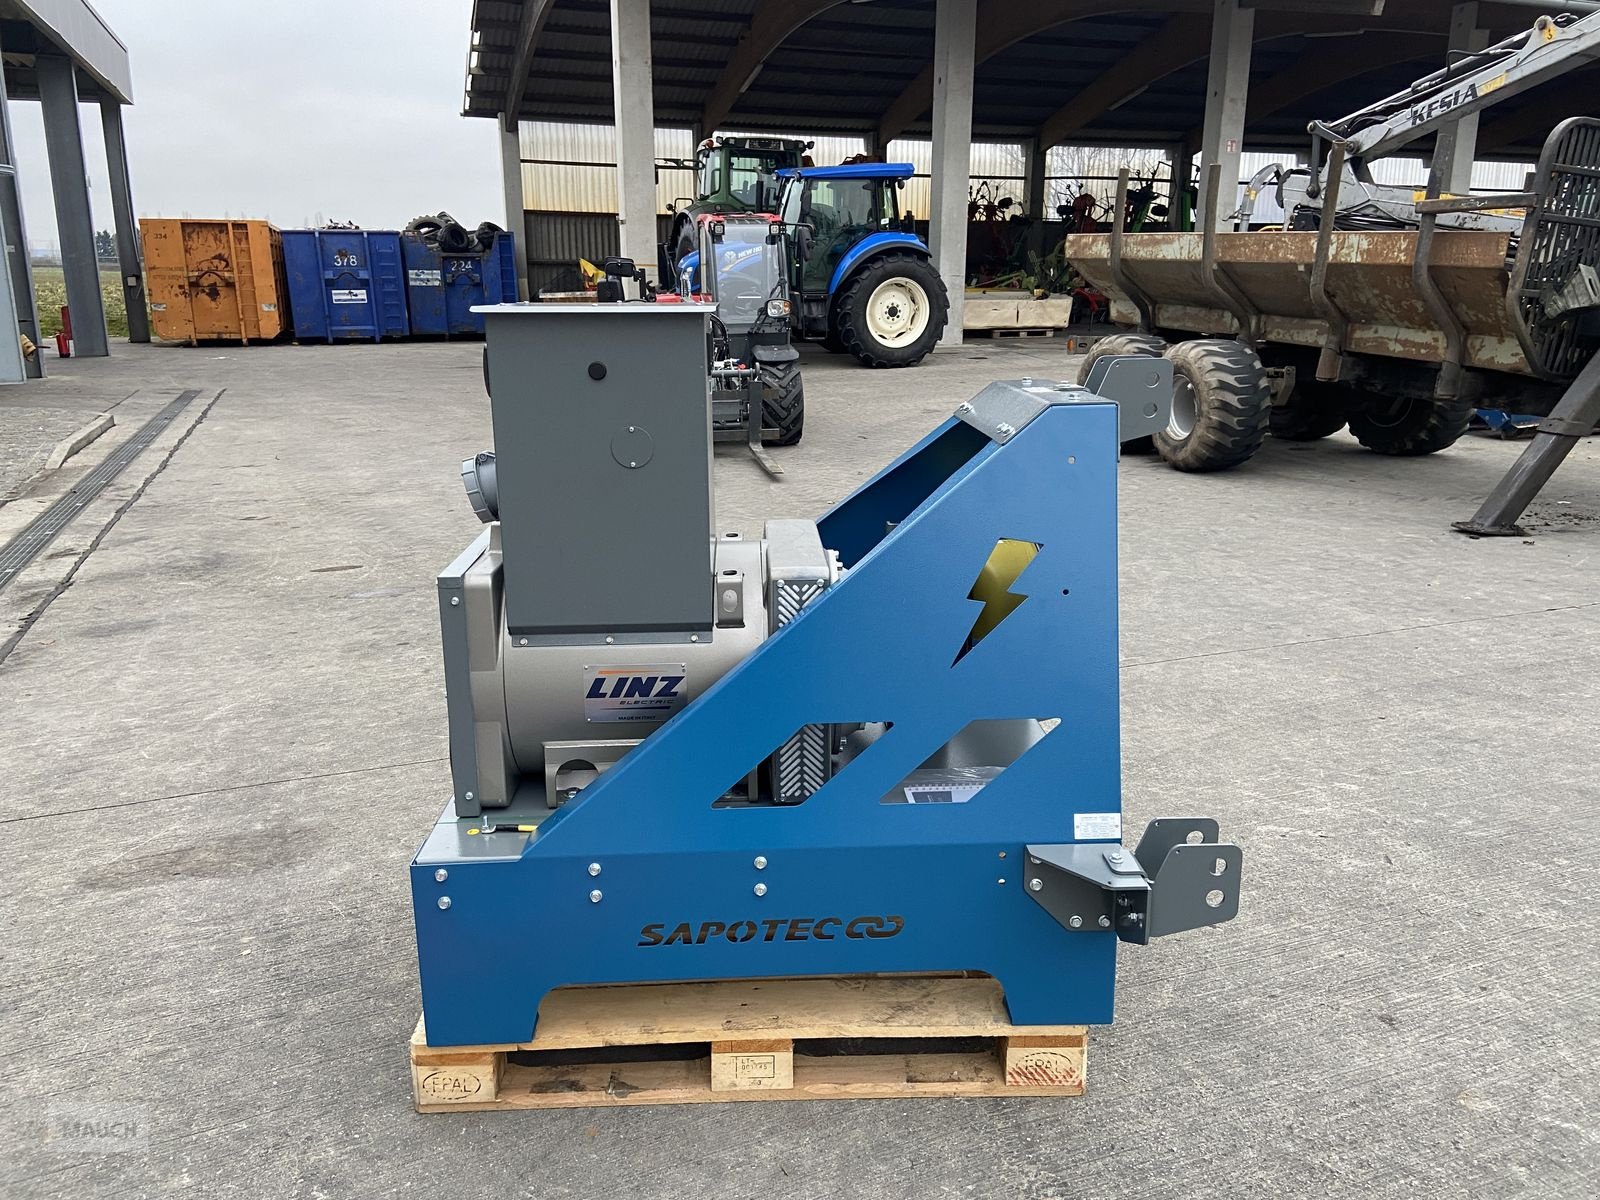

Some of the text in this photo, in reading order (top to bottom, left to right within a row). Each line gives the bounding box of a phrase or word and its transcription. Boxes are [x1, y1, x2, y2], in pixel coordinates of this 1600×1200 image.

[334, 255, 358, 266] 378
[585, 675, 686, 699] LINZ
[637, 917, 843, 947] SAPOTEC
